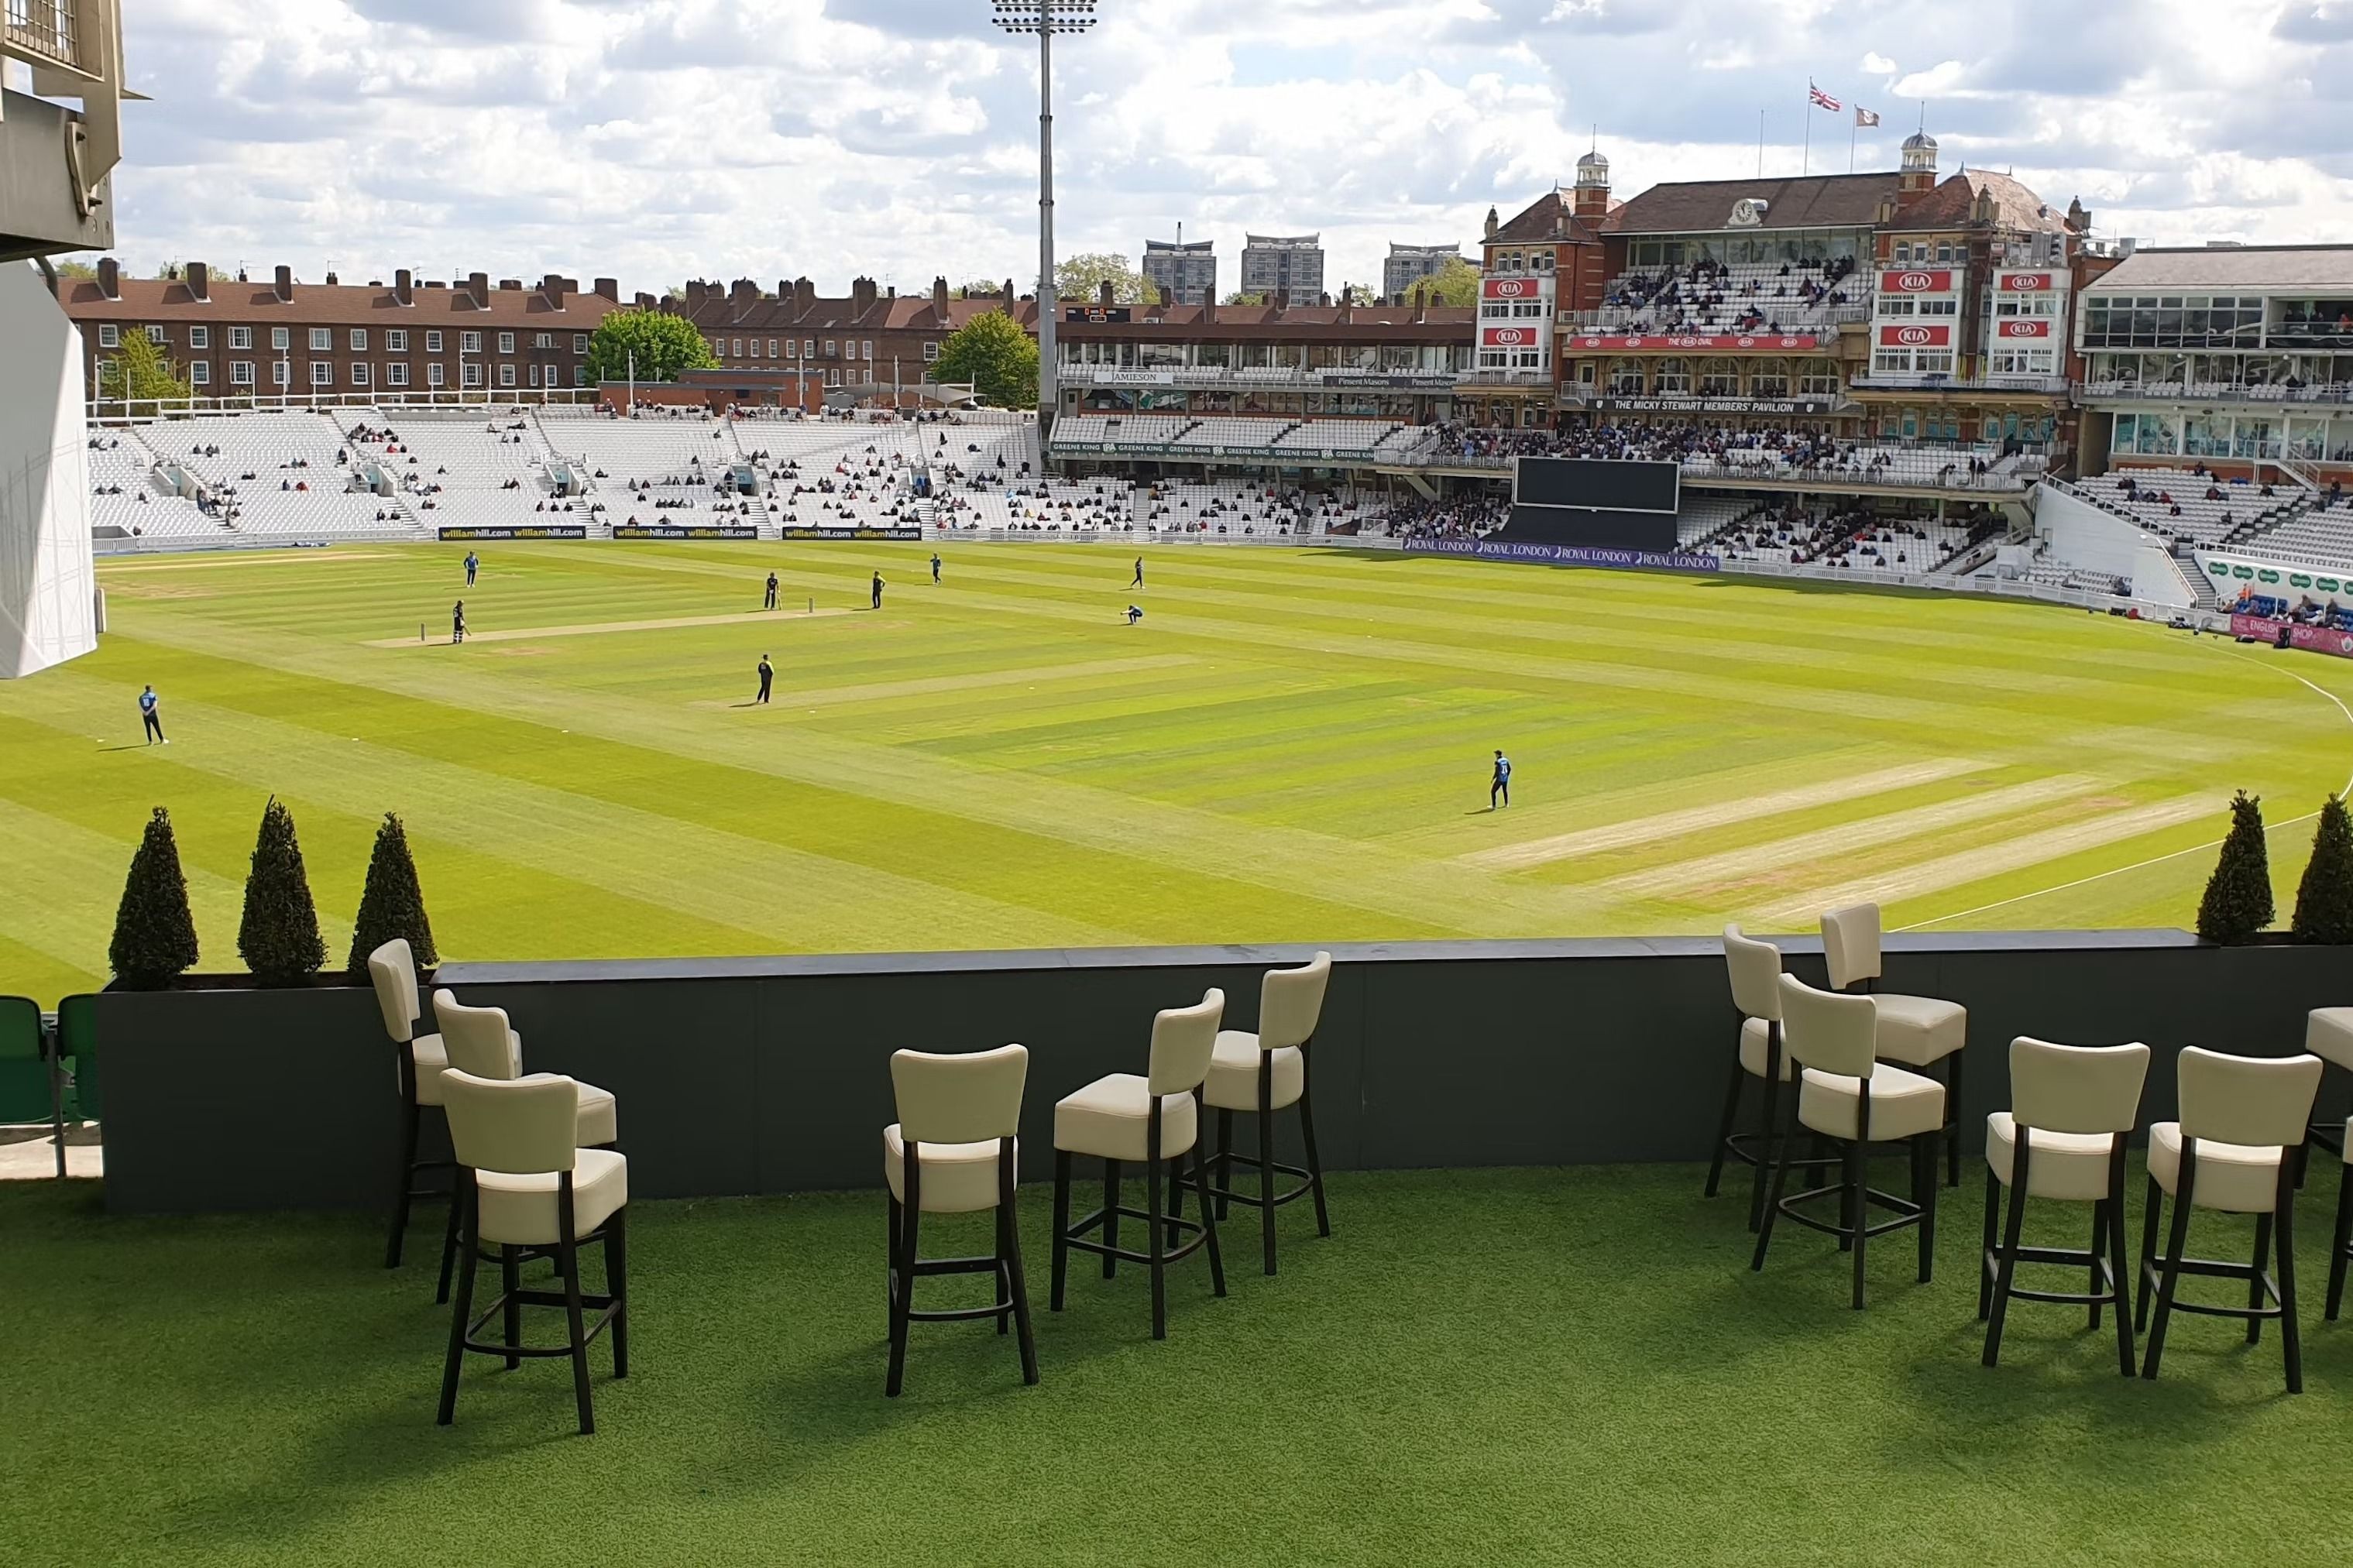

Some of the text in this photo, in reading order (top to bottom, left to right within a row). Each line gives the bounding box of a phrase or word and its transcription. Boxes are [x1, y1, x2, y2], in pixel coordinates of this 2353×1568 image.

[1111, 372, 1156, 382] JAMIESON
[1614, 400, 1795, 413] THE MICKY STEWART MEMBERS' PAVILION
[1103, 443, 1117, 452] IPA
[1212, 446, 1225, 455] IPA
[1321, 449, 1334, 459] IPA
[442, 527, 582, 538] williamhill.com williamhill.com
[616, 528, 754, 537] williamhill.com williamhill.com
[785, 529, 919, 539] williamhill.com williamhill.com
[1411, 539, 1474, 552] ROYAL LONDON
[1484, 543, 1551, 557] ROYAL LONDON
[1562, 547, 1631, 564] ROYAL LONDON
[1643, 554, 1716, 569] ROYAL LONDON
[2250, 619, 2279, 633] ENGLISH
[2293, 627, 2313, 639] SHOP
